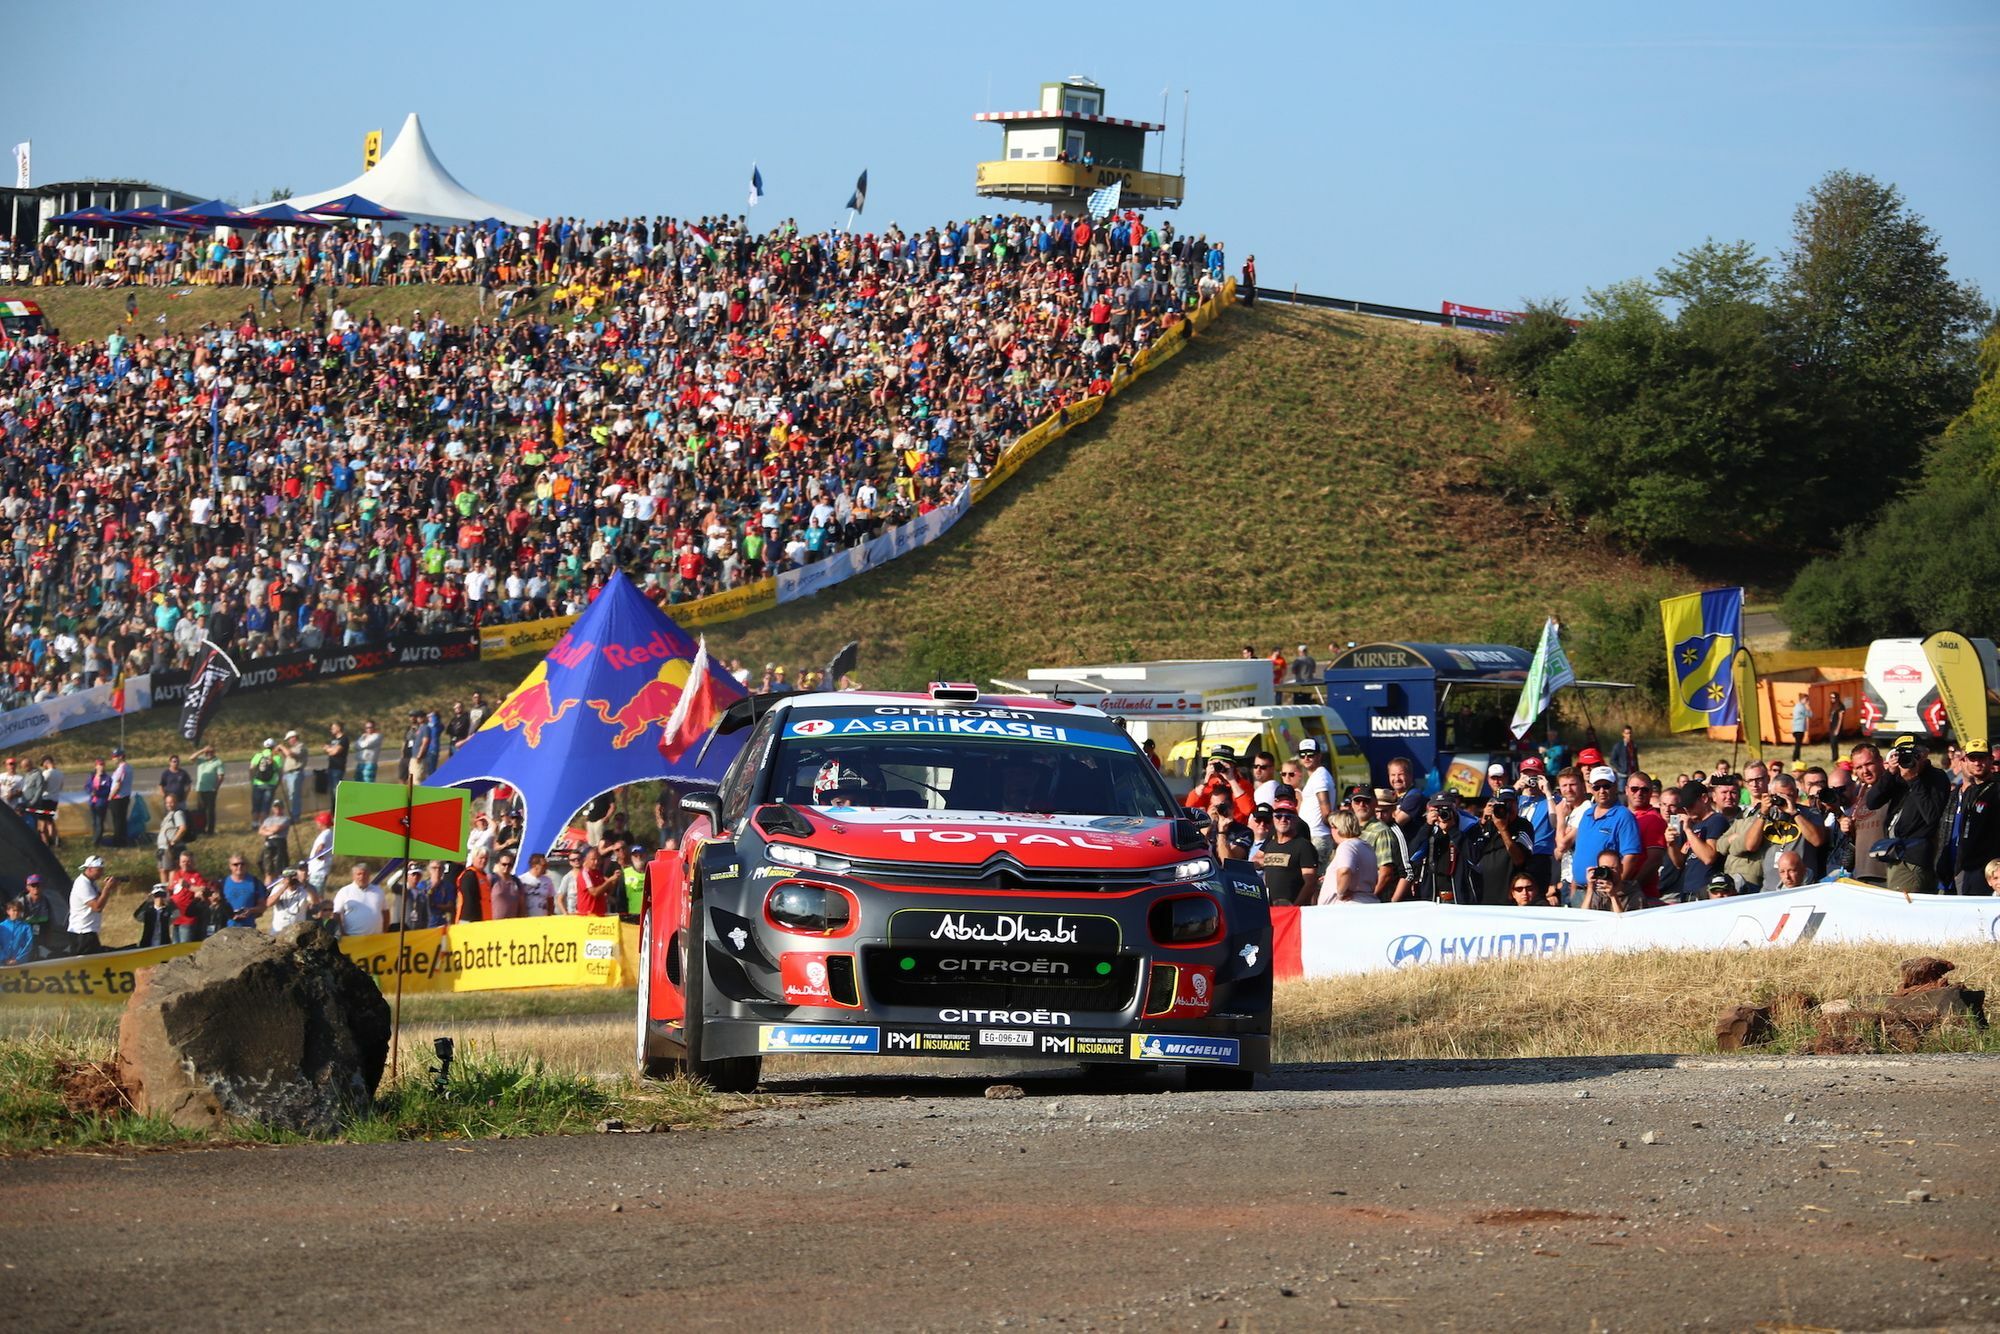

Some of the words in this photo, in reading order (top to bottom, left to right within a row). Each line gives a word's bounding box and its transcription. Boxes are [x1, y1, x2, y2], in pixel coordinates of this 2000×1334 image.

[1353, 652, 1408, 668] KIRNER
[1100, 697, 1154, 711] Grillmobil
[874, 706, 1035, 720] CITROËN
[1371, 715, 1429, 731] KIRNER
[681, 799, 709, 809] TOTAL
[883, 828, 1113, 851] TOTAL
[1233, 881, 1261, 893] PMI
[1440, 932, 1569, 964] HYUNDAI
[939, 958, 1069, 974] CITROËN
[938, 1009, 1071, 1025] CITROËN
[790, 1034, 869, 1045] MICHELIN
[887, 1032, 921, 1049] PMI
[923, 1039, 971, 1051] INSURANCE
[984, 1033, 1028, 1043] EG-096-ZW
[1041, 1036, 1074, 1053] PMI
[1077, 1043, 1124, 1055] INSURANCE
[1165, 1043, 1232, 1056] MICHELIN
